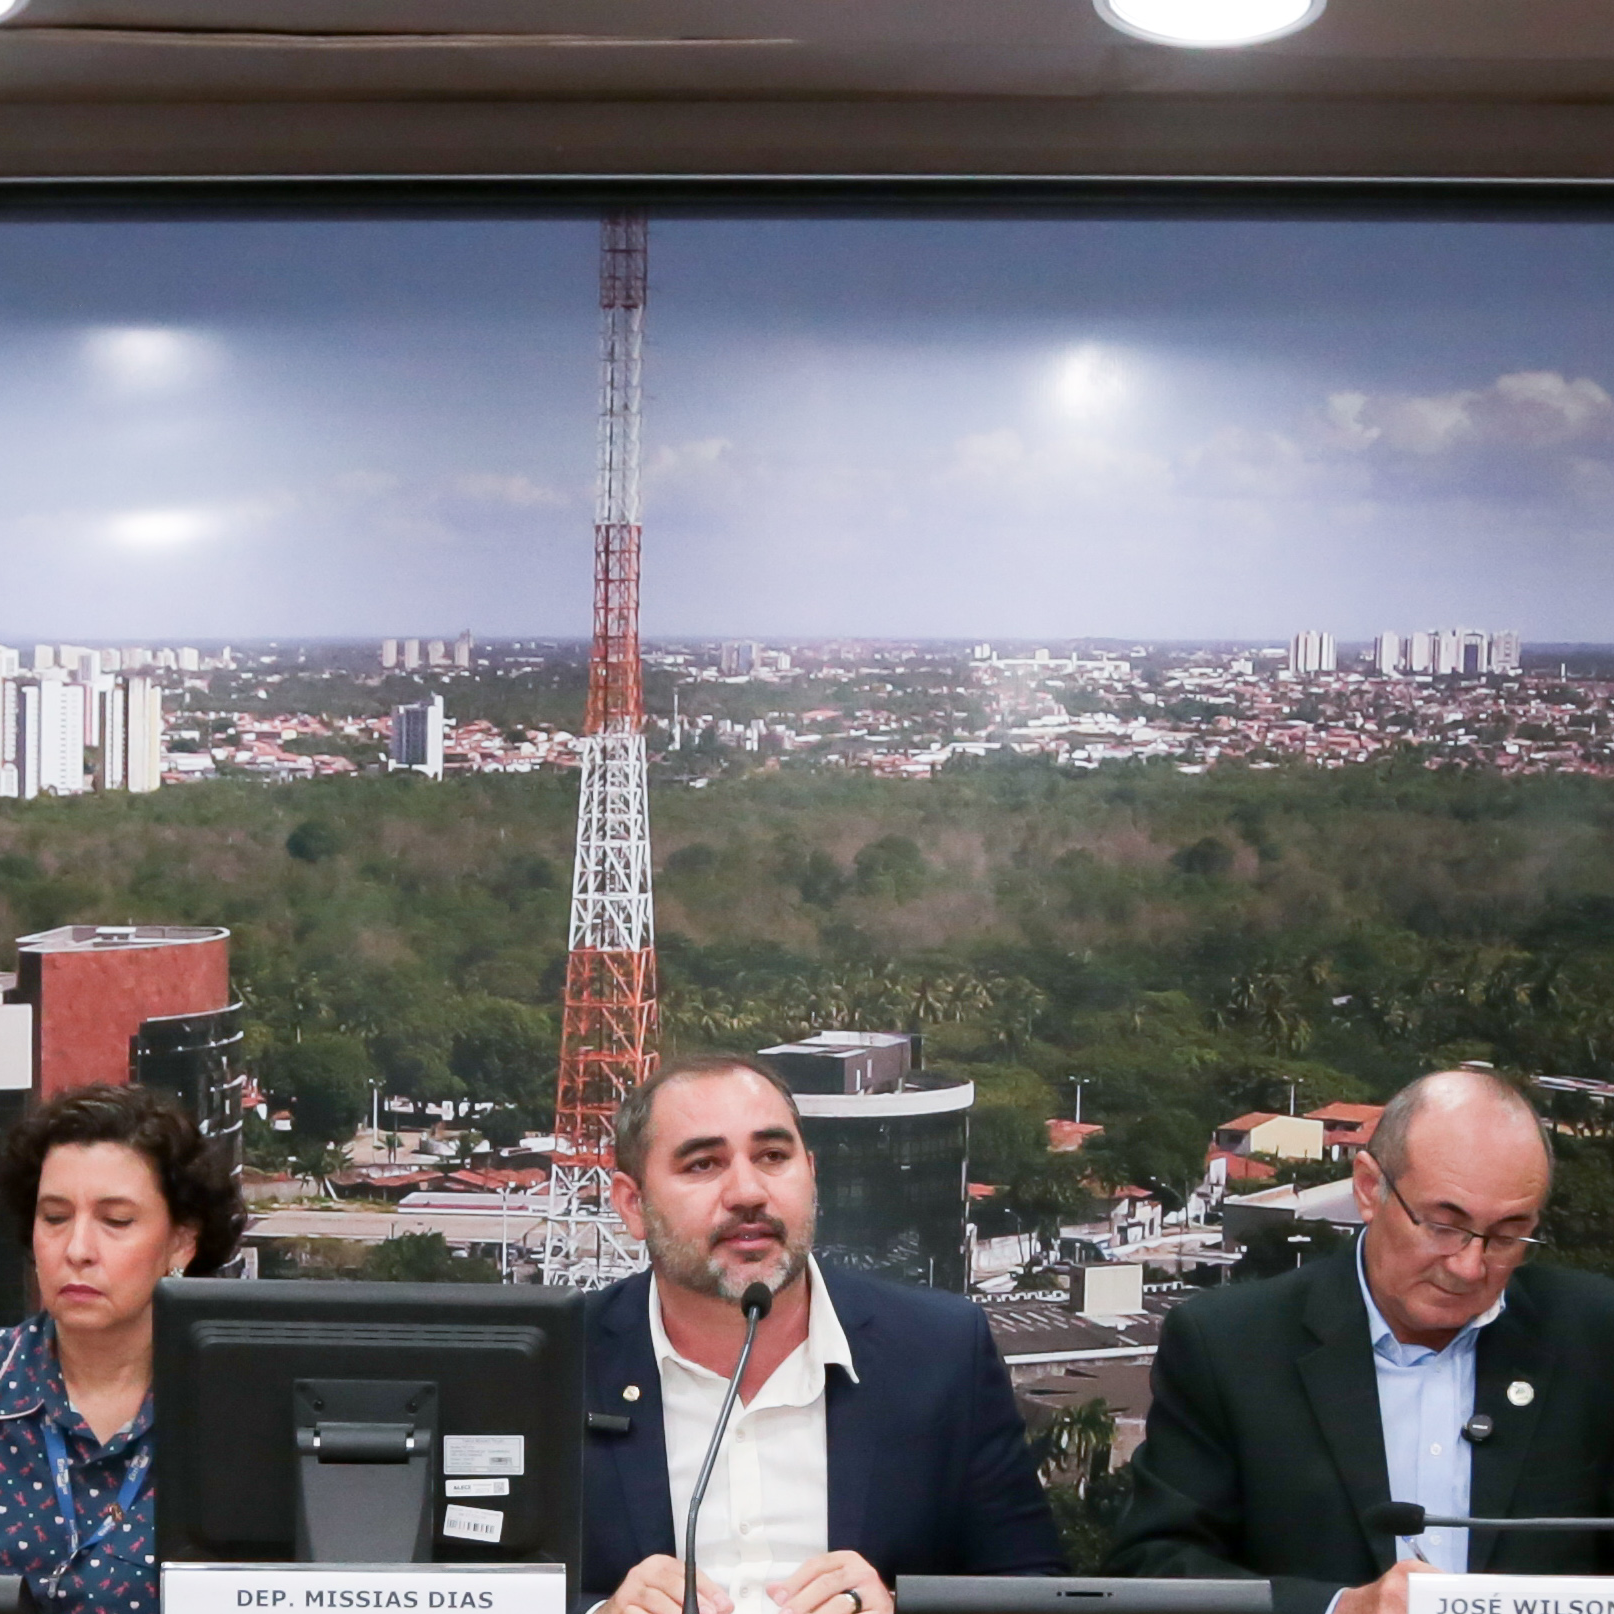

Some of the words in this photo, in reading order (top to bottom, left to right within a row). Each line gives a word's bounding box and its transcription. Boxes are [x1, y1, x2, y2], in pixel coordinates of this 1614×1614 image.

[237, 1589, 294, 1608] DEP.
[305, 1590, 418, 1609] MISSIAS
[428, 1591, 494, 1610] DIAS
